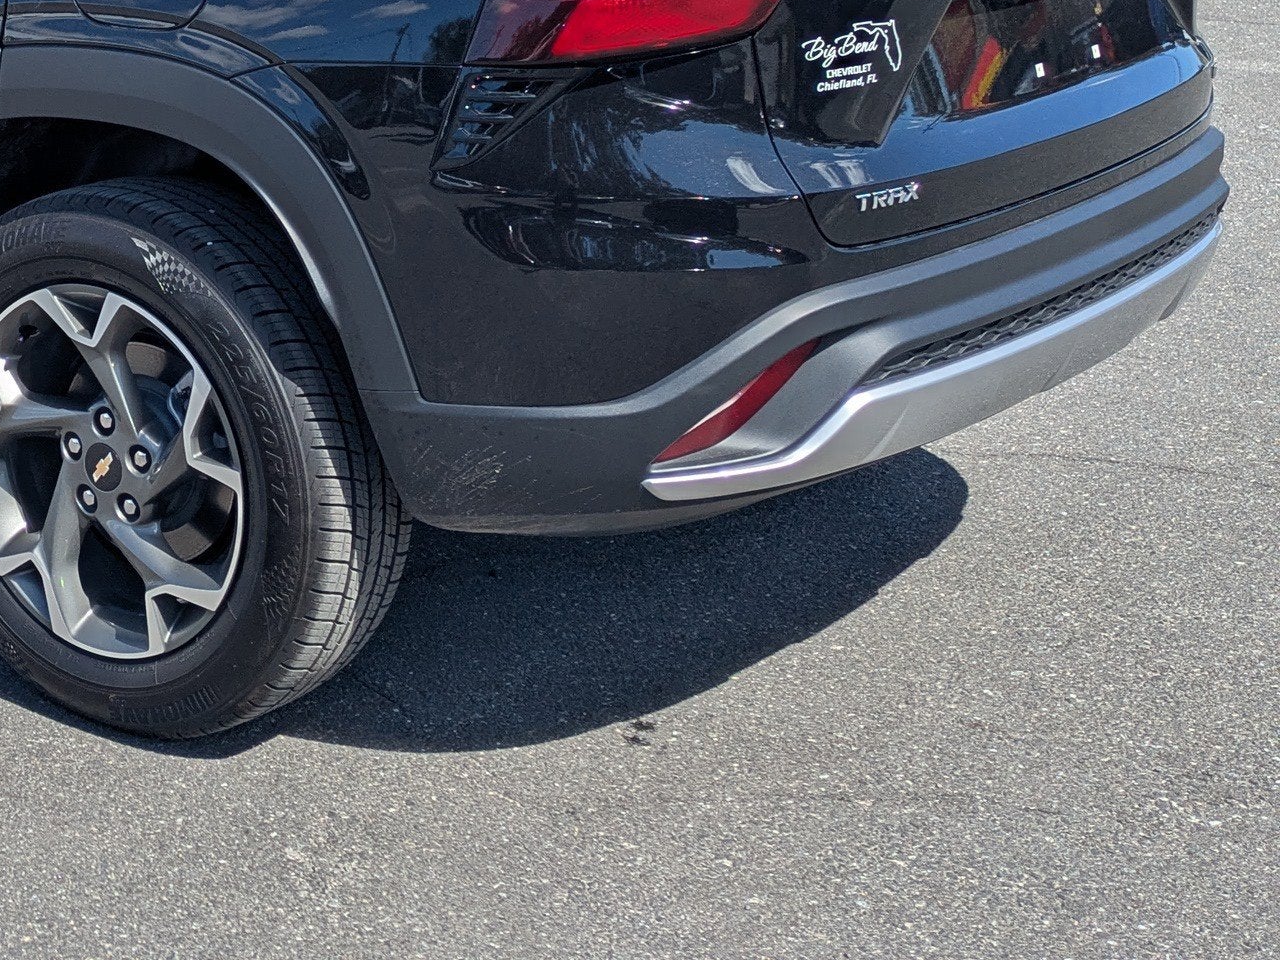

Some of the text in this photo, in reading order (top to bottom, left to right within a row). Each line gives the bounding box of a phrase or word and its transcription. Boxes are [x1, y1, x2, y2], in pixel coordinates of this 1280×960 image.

[801, 31, 880, 68] Big Bend
[816, 74, 878, 93] Chiefland, FL
[826, 63, 872, 79] CHEVROLET
[855, 181, 919, 212] TRAX
